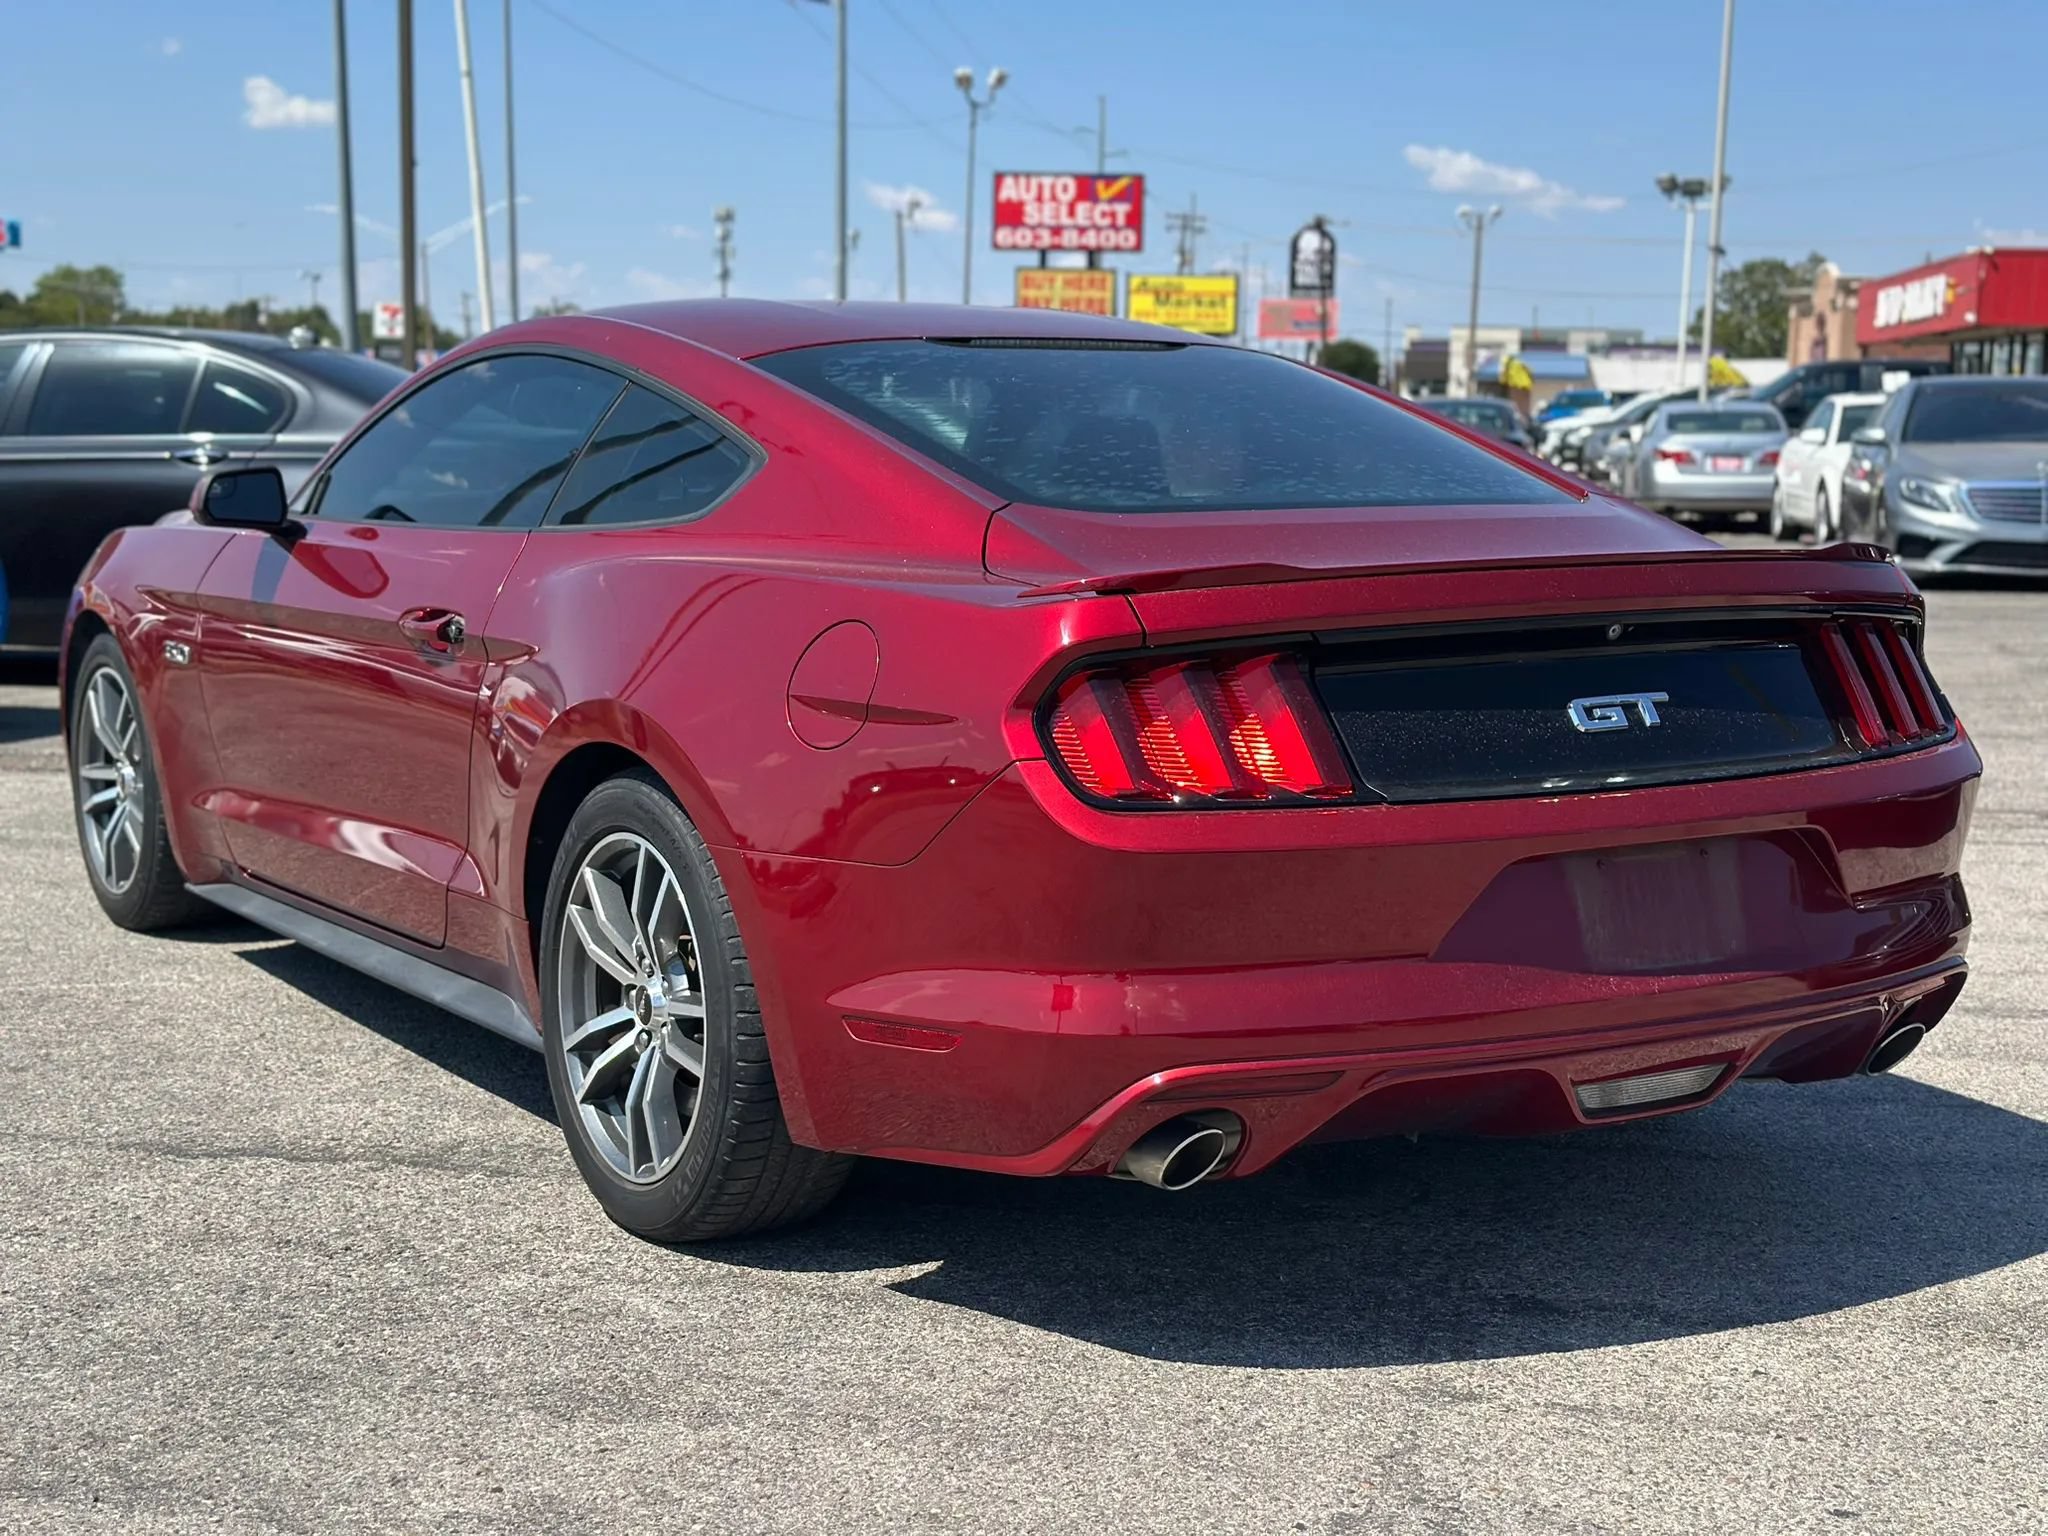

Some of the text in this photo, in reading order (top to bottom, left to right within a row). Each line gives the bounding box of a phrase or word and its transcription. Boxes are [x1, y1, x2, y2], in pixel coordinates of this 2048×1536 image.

[998, 175, 1077, 203] AUTO
[1021, 201, 1132, 227] SELECT
[995, 225, 1138, 249] 603-8400
[1062, 275, 1106, 291] HERE
[1153, 289, 1227, 308] Market
[1567, 691, 1669, 733] GT
